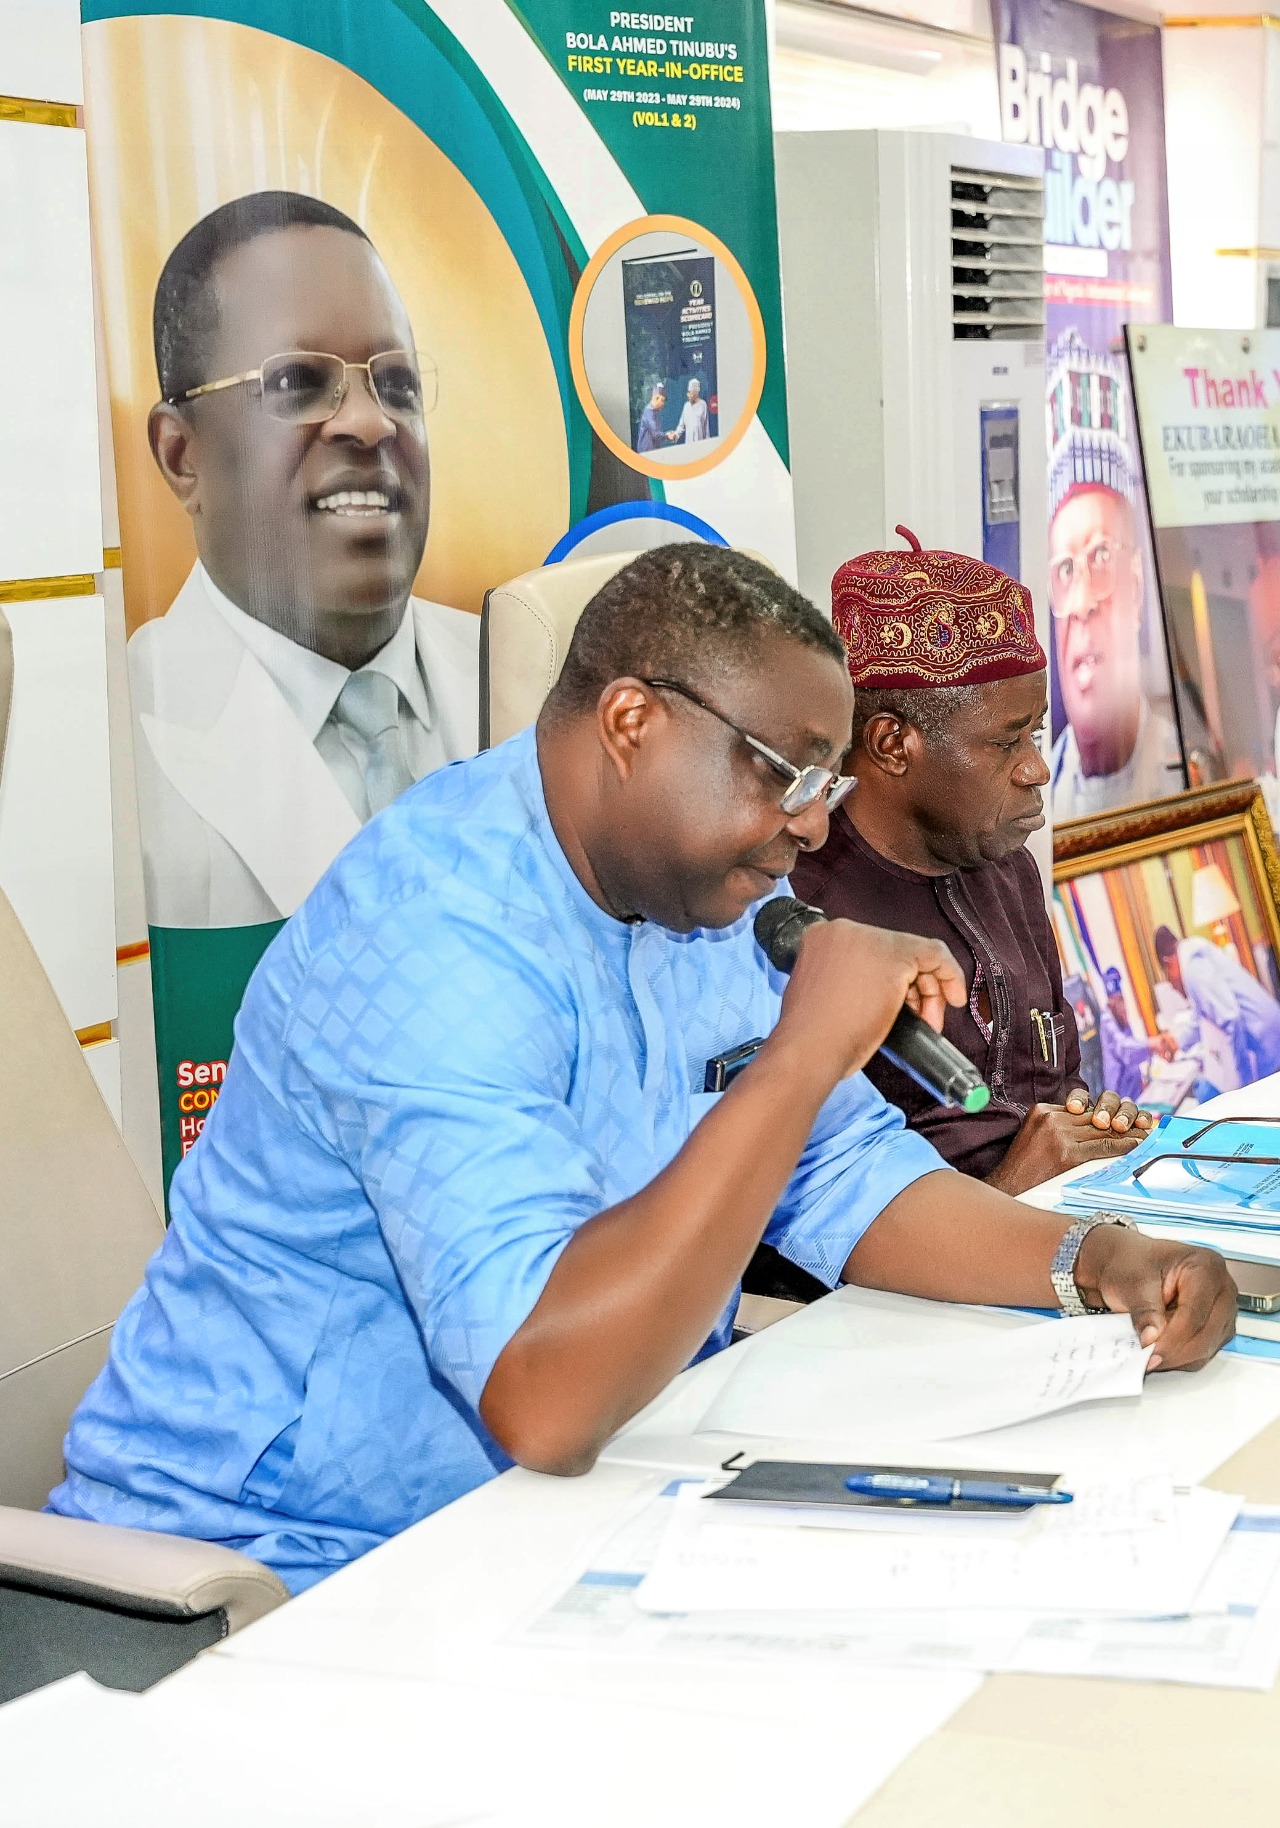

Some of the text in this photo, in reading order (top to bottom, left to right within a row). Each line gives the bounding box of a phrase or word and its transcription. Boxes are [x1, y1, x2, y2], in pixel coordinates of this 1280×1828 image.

[610, 11, 694, 33] PRESIDENT
[566, 32, 737, 60] BOLA AHMED TINUBU'S
[568, 55, 744, 83] FIRST YEAR-IN-OFFICE
[583, 88, 608, 102] (MAY
[610, 90, 634, 103] 29TH
[636, 92, 660, 104] 2023
[667, 95, 687, 106] MAY
[689, 96, 713, 107] 29TH
[714, 97, 740, 110] 2024)
[1001, 43, 1129, 183] Bridge
[632, 111, 697, 130] (VOL1 & 2)
[1044, 151, 1135, 250] ilder
[1183, 368, 1269, 409] Thank
[1168, 456, 1185, 477] For
